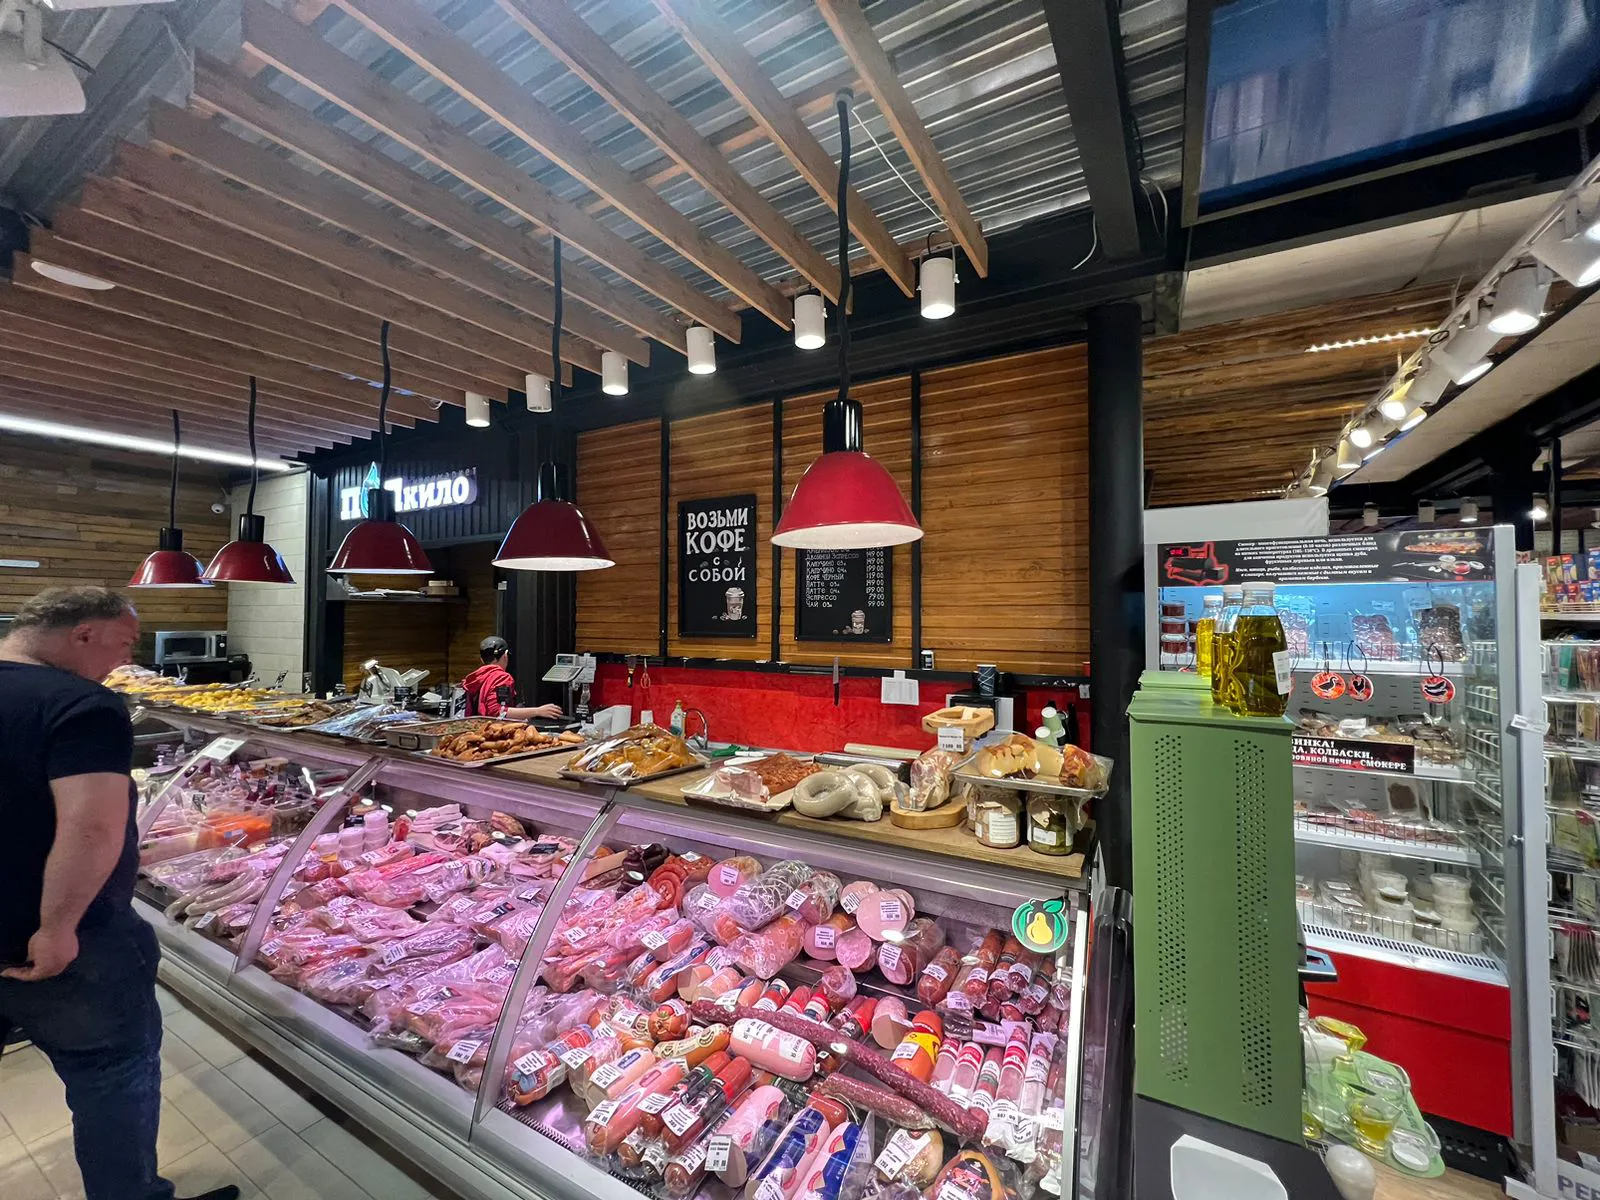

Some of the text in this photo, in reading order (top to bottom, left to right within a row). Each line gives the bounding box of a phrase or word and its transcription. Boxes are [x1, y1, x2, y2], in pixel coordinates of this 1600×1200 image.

[687, 508, 748, 530] ВОЗЬМИ
[686, 528, 746, 555] КОФЕ
[688, 566, 746, 582] СОБОЙ
[1310, 746, 1374, 759] КОЛБАСКИ,
[1360, 759, 1407, 771] СМОКЕРЕ
